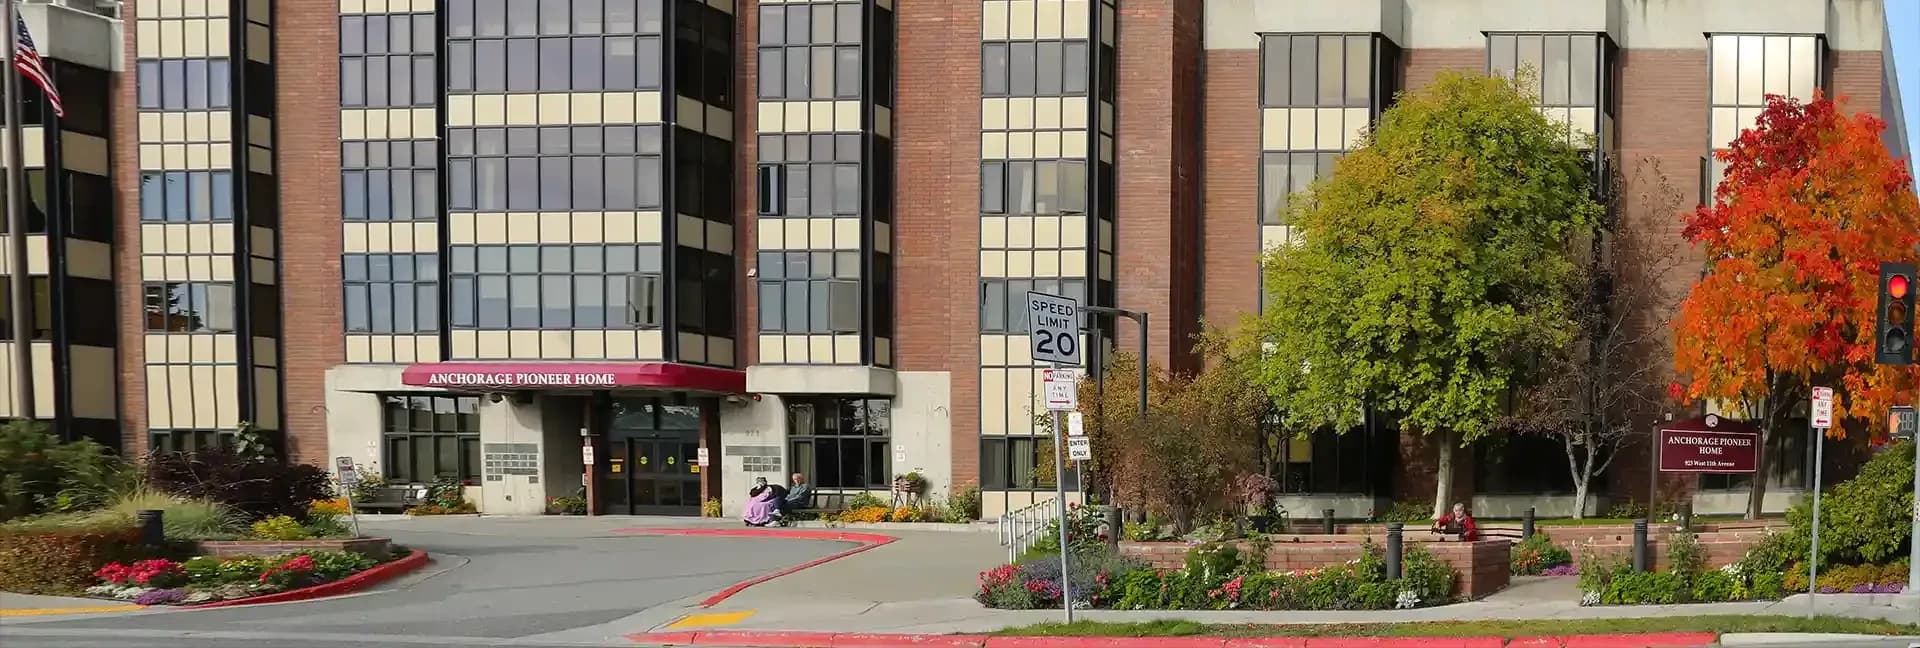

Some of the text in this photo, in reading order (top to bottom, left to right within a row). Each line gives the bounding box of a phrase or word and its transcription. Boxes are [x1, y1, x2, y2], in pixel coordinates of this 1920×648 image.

[1032, 300, 1074, 317] SPEED
[1038, 315, 1069, 329] LIMIT
[1035, 329, 1075, 357] 20
[429, 373, 616, 385] ANCHORAGE PIONEER HOME
[1044, 371, 1053, 381] NO
[1668, 436, 1752, 446] ANCHORAGE PIONEER
[1699, 446, 1723, 455] HOME
